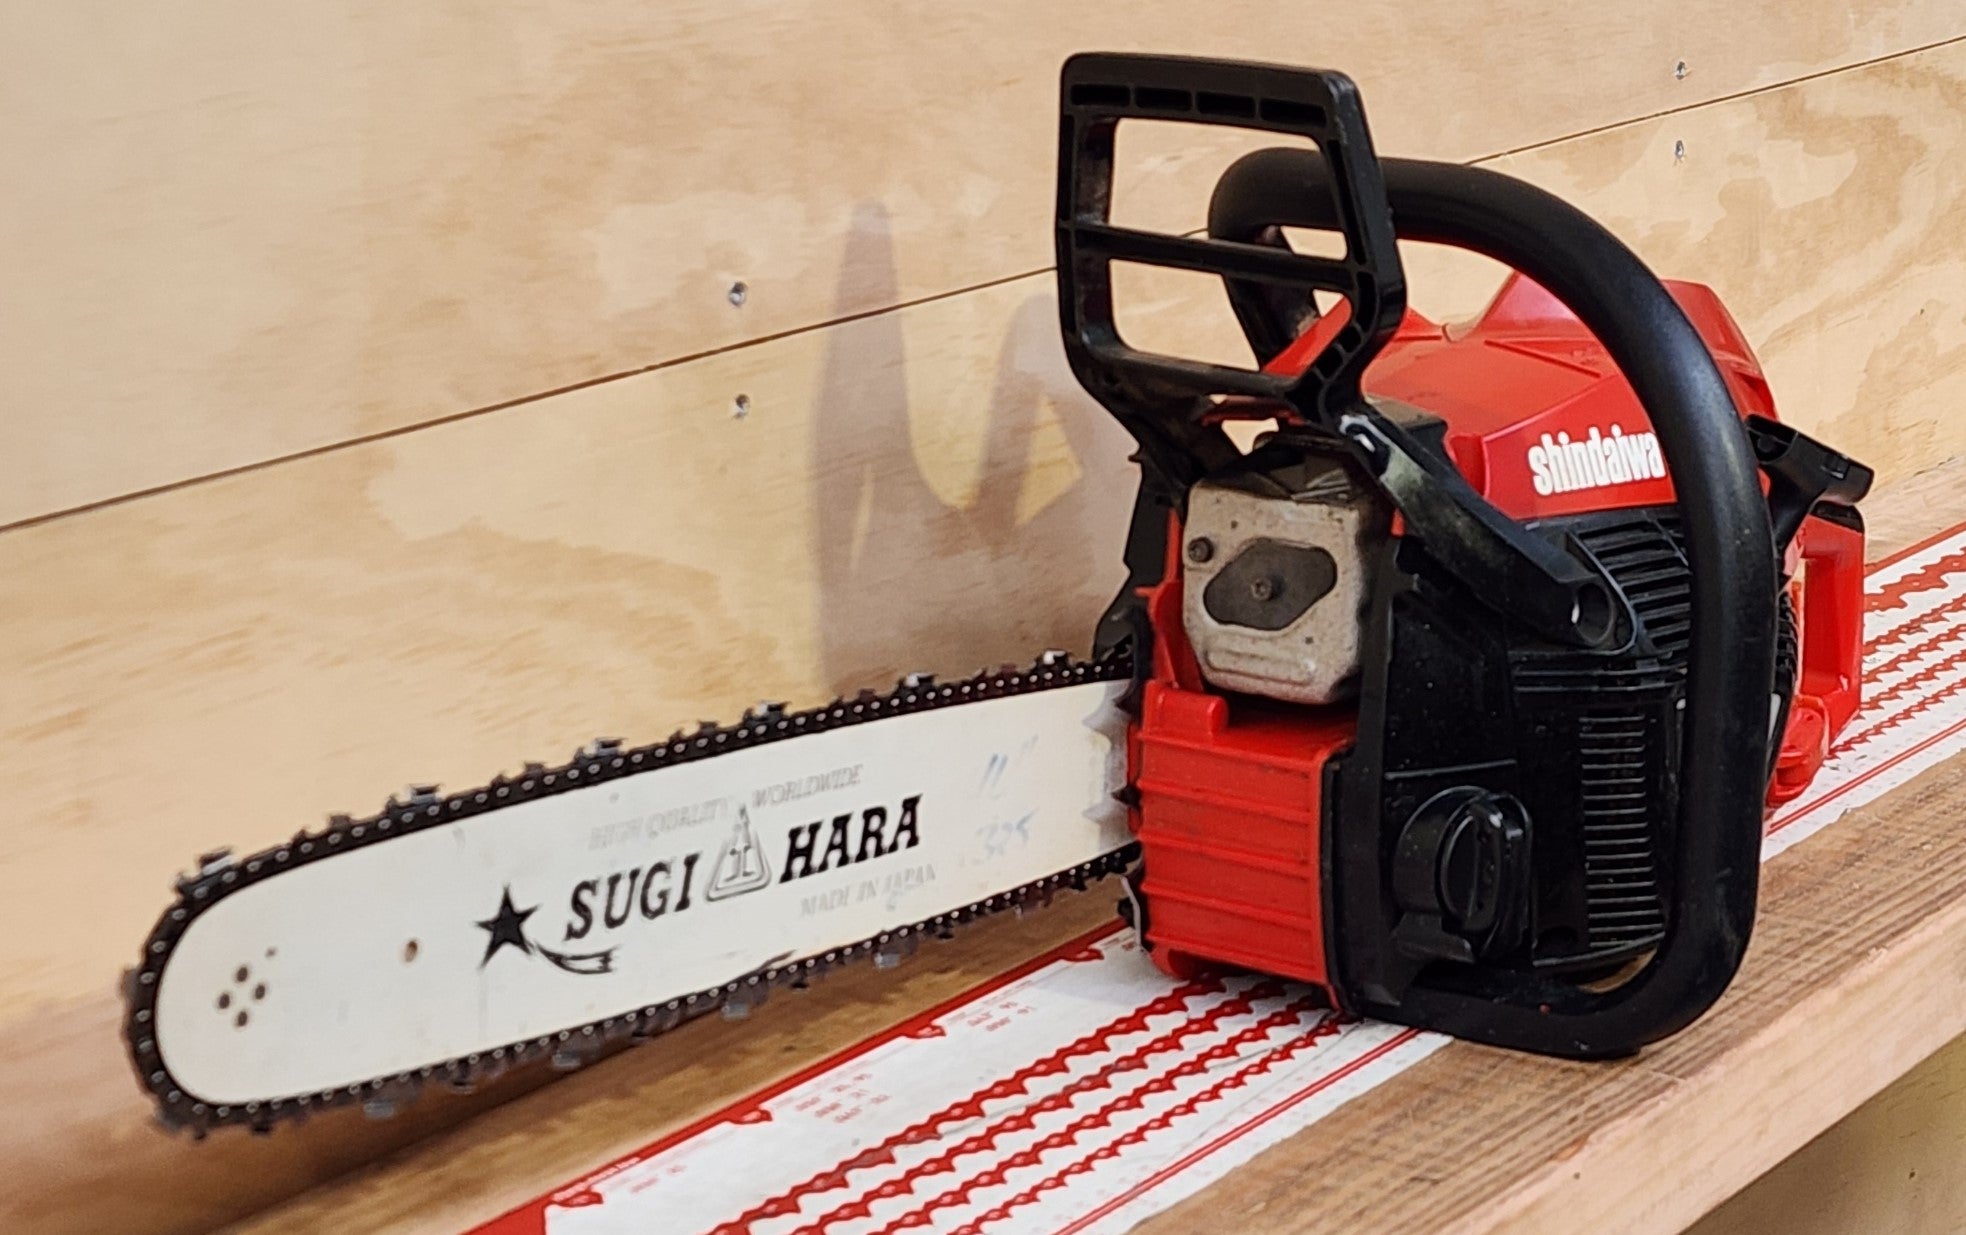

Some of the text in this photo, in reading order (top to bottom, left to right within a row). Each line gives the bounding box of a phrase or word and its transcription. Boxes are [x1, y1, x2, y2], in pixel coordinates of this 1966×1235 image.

[1528, 423, 1666, 496] shindaiwa
[751, 764, 863, 808] WORLDWIDE
[563, 795, 924, 941] SUGI HARA
